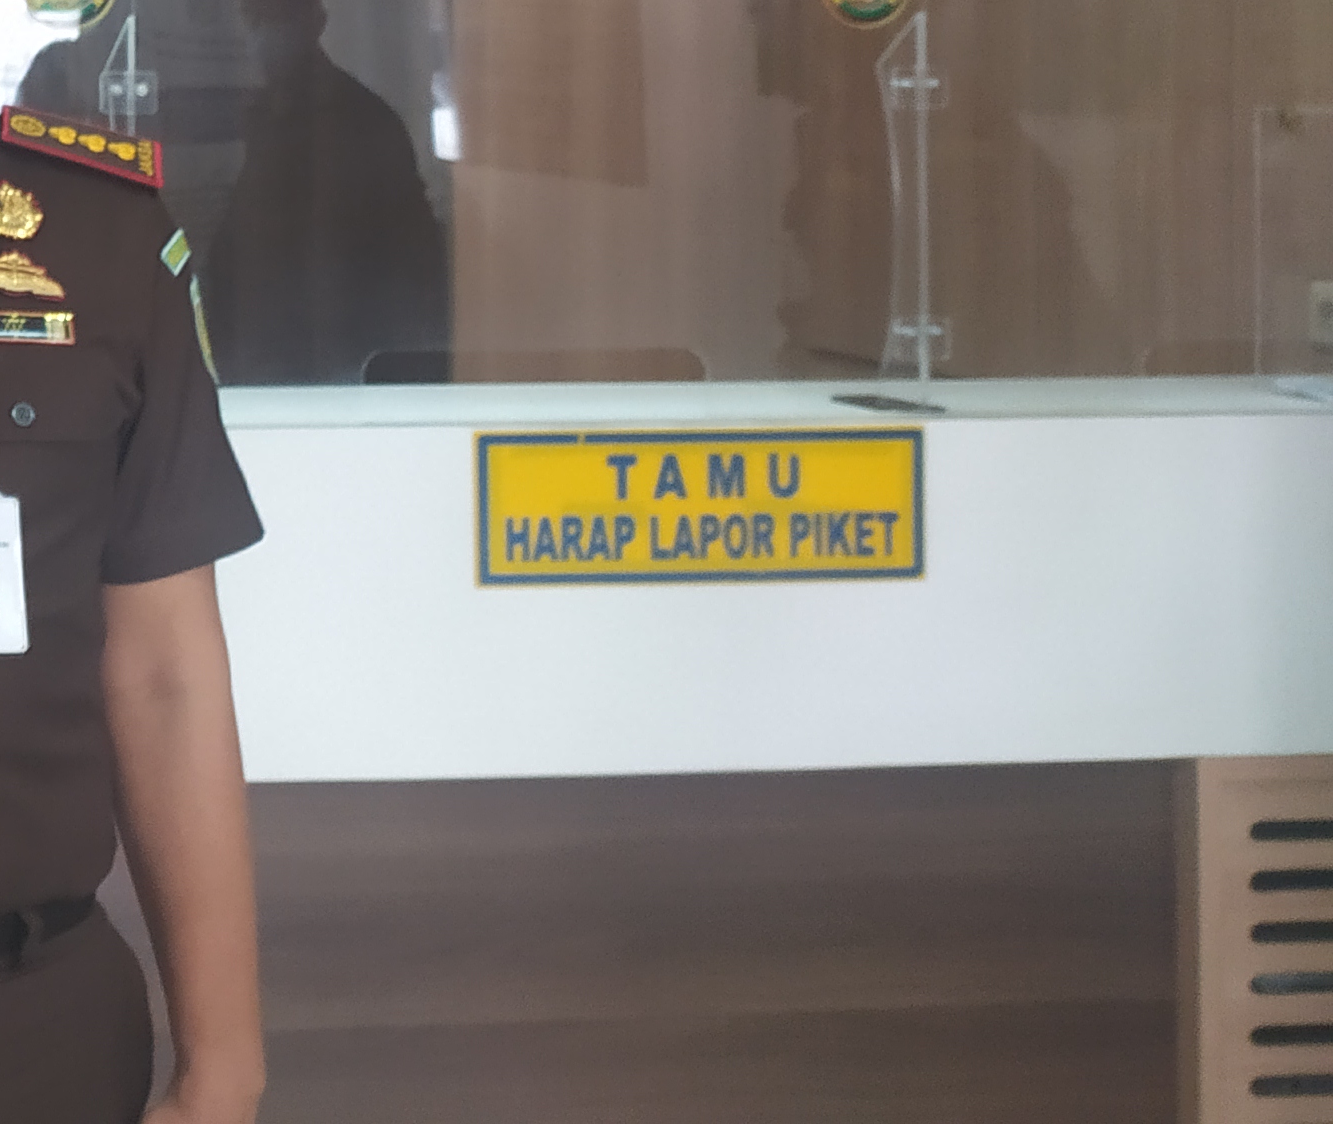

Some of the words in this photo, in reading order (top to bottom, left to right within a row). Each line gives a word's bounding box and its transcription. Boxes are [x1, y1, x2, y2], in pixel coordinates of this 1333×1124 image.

[505, 515, 636, 562] HARAP
[649, 513, 775, 561] LAPOR
[789, 511, 899, 558] PIKET
